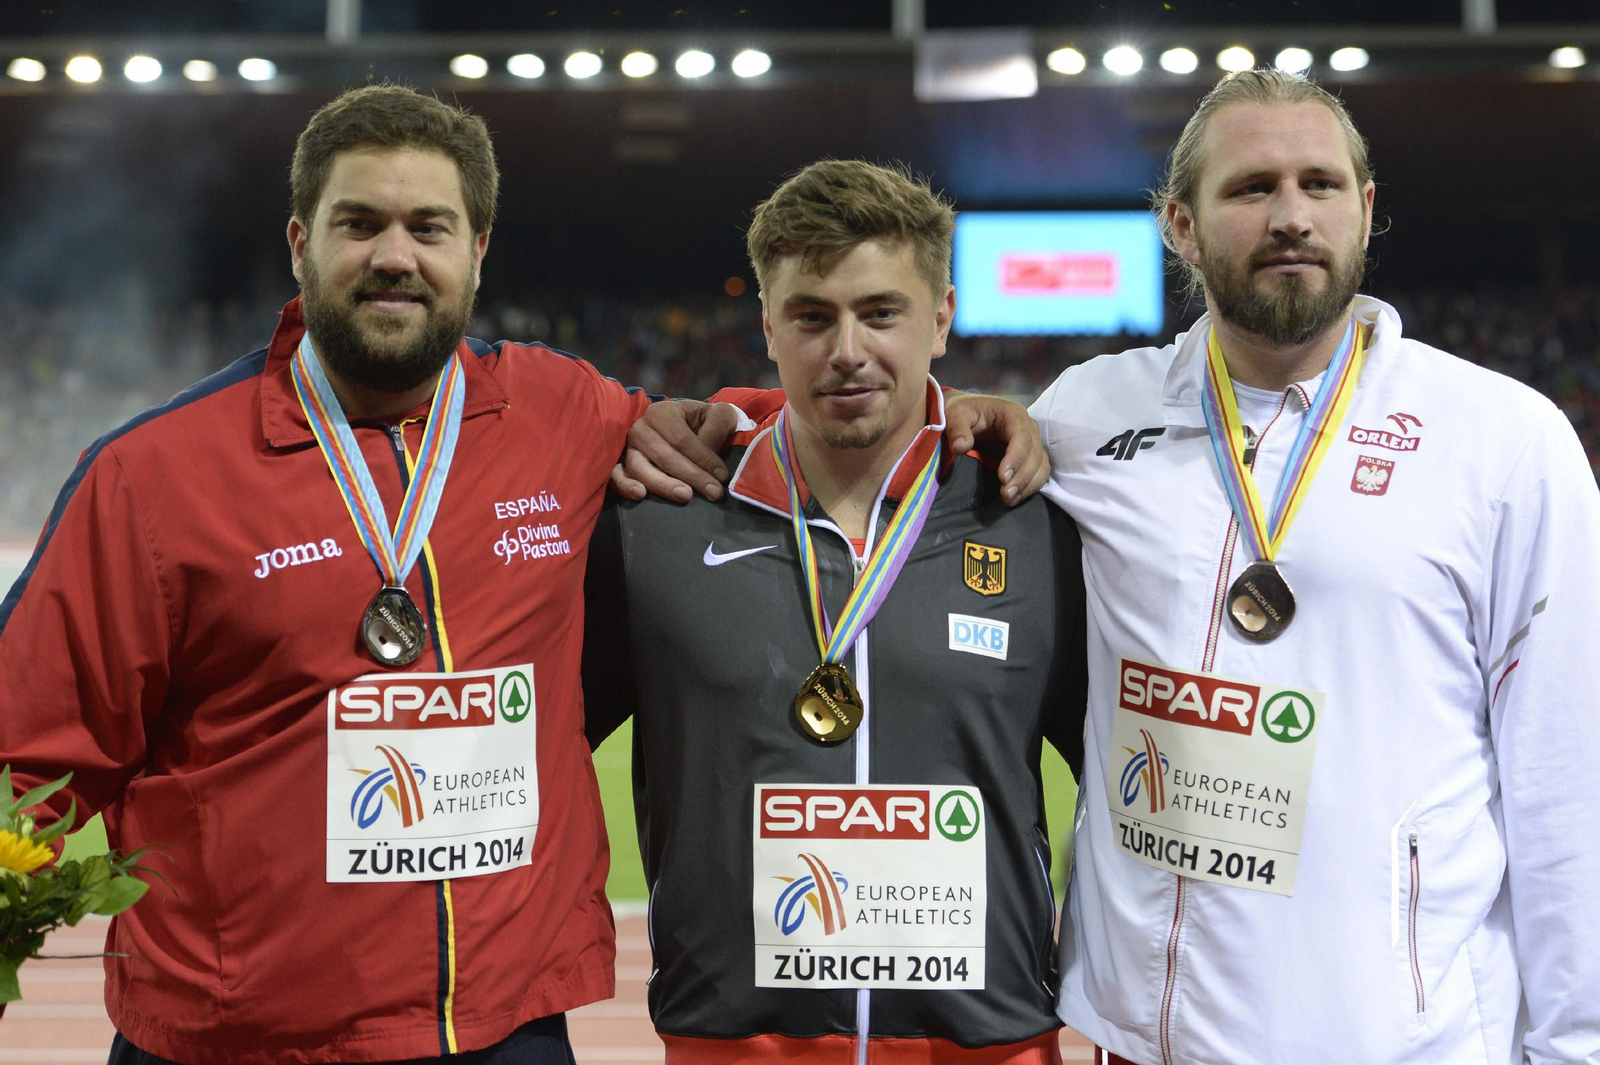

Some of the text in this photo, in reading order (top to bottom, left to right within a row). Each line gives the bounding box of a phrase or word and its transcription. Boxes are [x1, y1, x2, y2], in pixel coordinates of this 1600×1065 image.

[1352, 429, 1417, 450] ORLEN
[1360, 456, 1393, 468] POLSKA
[494, 489, 562, 520] ESPAÑA
[517, 522, 560, 544] Divina
[521, 539, 571, 561] Pastora
[1243, 581, 1282, 622] ZÜRICH 2014
[379, 606, 414, 649] ZÜRICH 2014
[953, 621, 1004, 651] DKB
[340, 682, 493, 723] SPAR
[813, 683, 850, 726] ZÜRICH 2014
[1123, 667, 1254, 727] SPAR
[433, 766, 525, 791] EUROPEAN
[1173, 769, 1291, 806] EUROPEAN
[432, 789, 527, 815] ATHLETICS
[764, 795, 926, 833] SPAR
[1171, 793, 1288, 829] ATHLETICS
[348, 836, 524, 875] ZÜRICH 2014
[1118, 821, 1276, 885] ZÜRICH 2014
[856, 885, 973, 902] EUROPEAN
[856, 908, 972, 925] ATHLETICS
[774, 947, 969, 982] ZÜRICH 2014
